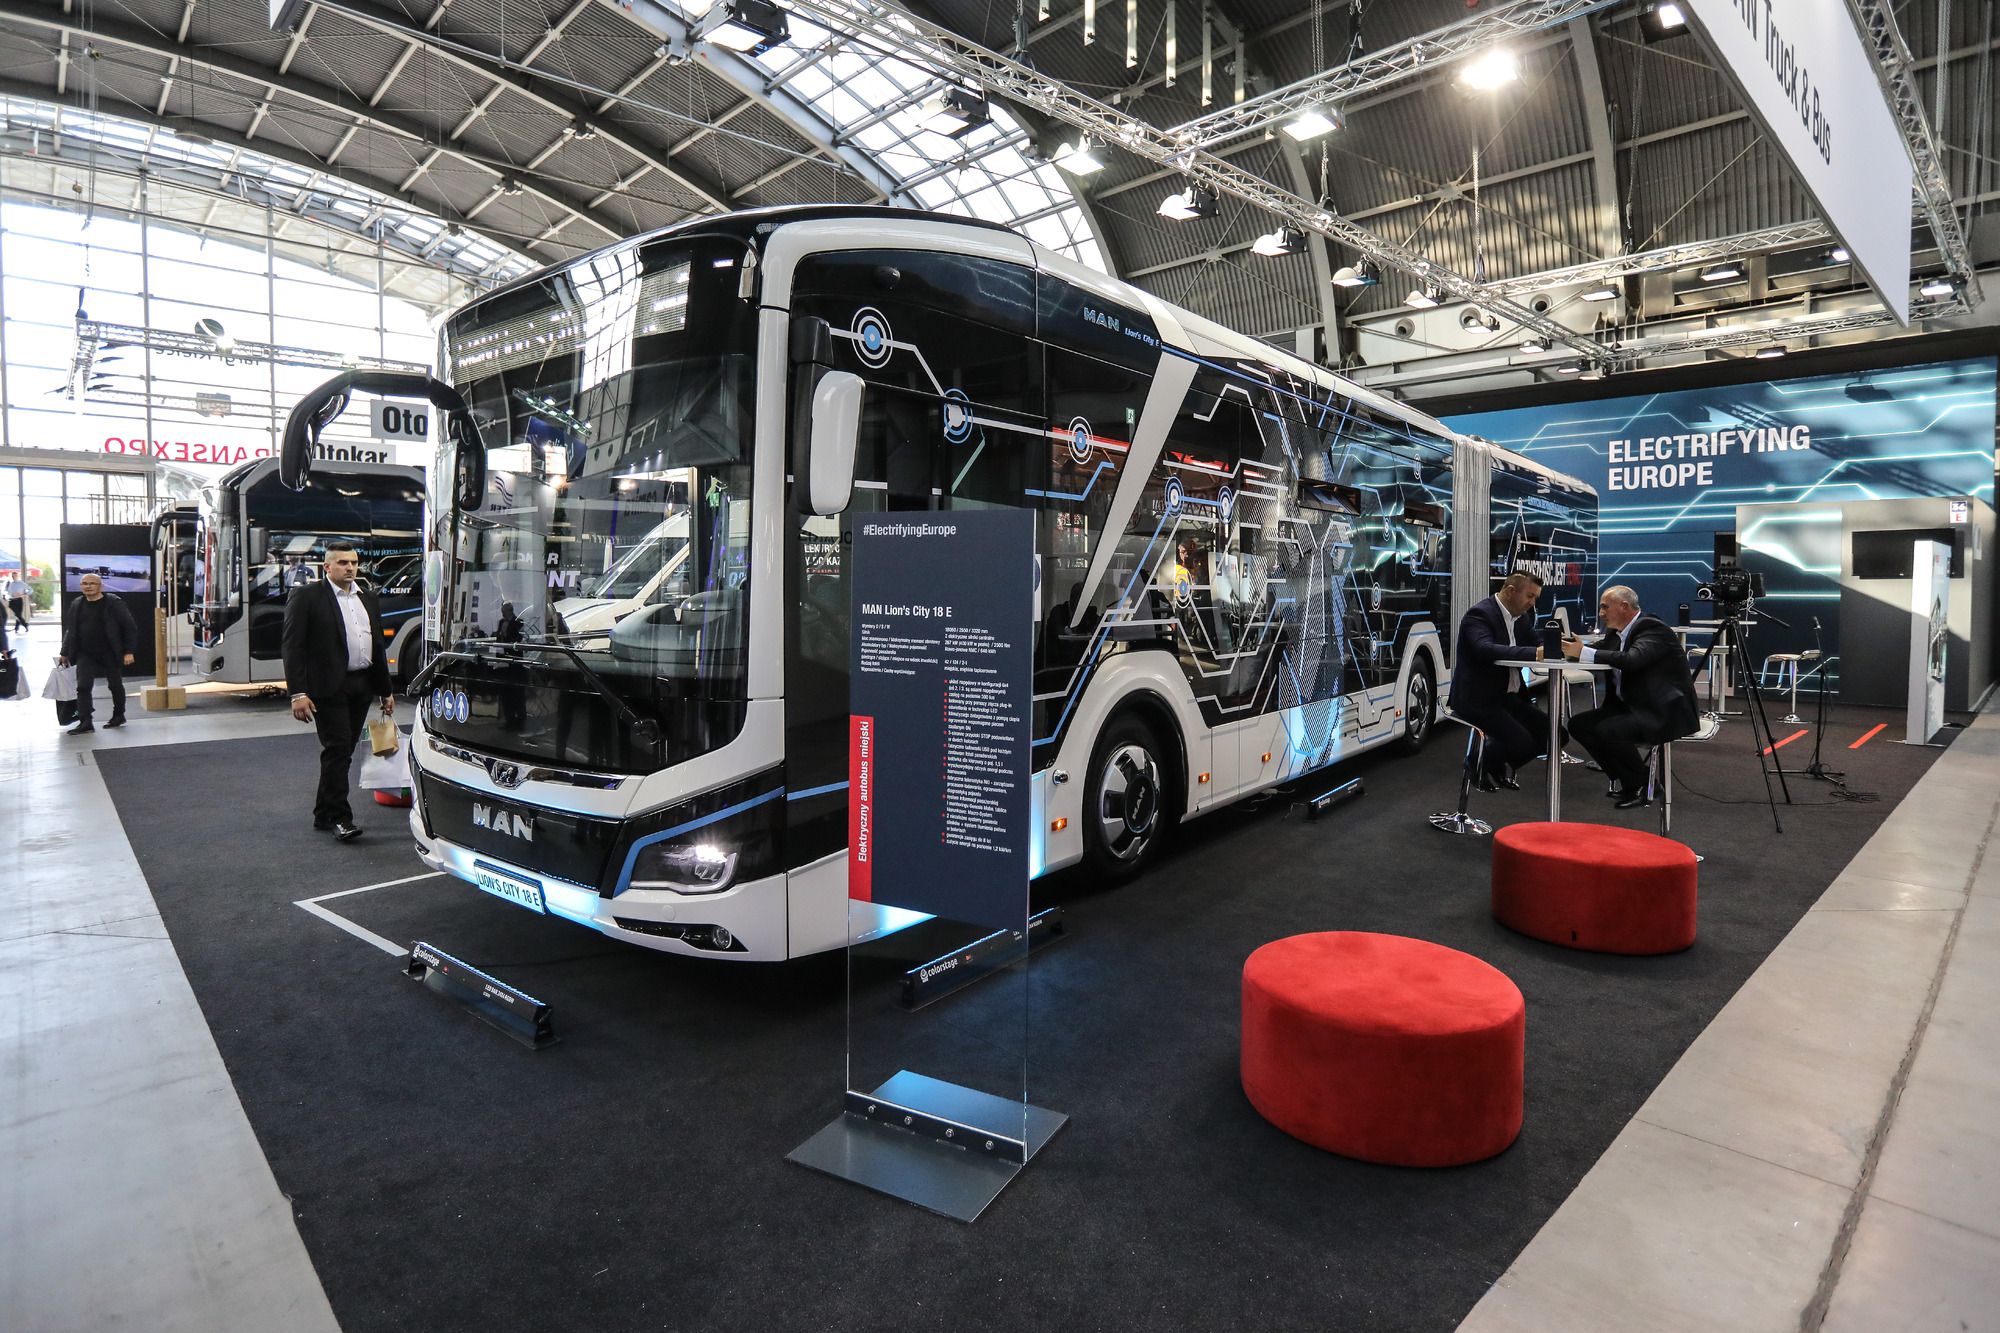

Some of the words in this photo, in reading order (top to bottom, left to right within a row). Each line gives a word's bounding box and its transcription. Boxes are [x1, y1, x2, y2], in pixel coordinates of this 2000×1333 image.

[1764, 0, 1798, 112] Truck
[1801, 68, 1810, 132] &
[1813, 86, 1831, 166] Bus
[1083, 307, 1120, 332] MAN
[1608, 425, 1810, 464] ELECTRIFYING
[1607, 462, 1713, 491] EUROPE
[863, 523, 957, 537] #ElectrifyingEurope
[1956, 513, 1965, 522] E
[1553, 563, 1566, 586] JEST
[862, 604, 882, 615] MAN
[885, 605, 910, 616] Lion's
[912, 605, 930, 618] City
[933, 606, 943, 617] 18
[946, 607, 952, 617] E
[859, 721, 870, 758] miejski
[860, 760, 869, 801] autobus
[473, 803, 534, 842] MAN
[858, 804, 870, 863] Elektryczny
[477, 871, 502, 893] LION'S
[502, 881, 521, 899] CITY
[522, 889, 532, 904] 18
[532, 892, 540, 907] E
[418, 948, 440, 967] colorstage
[928, 957, 958, 977] colorstage
